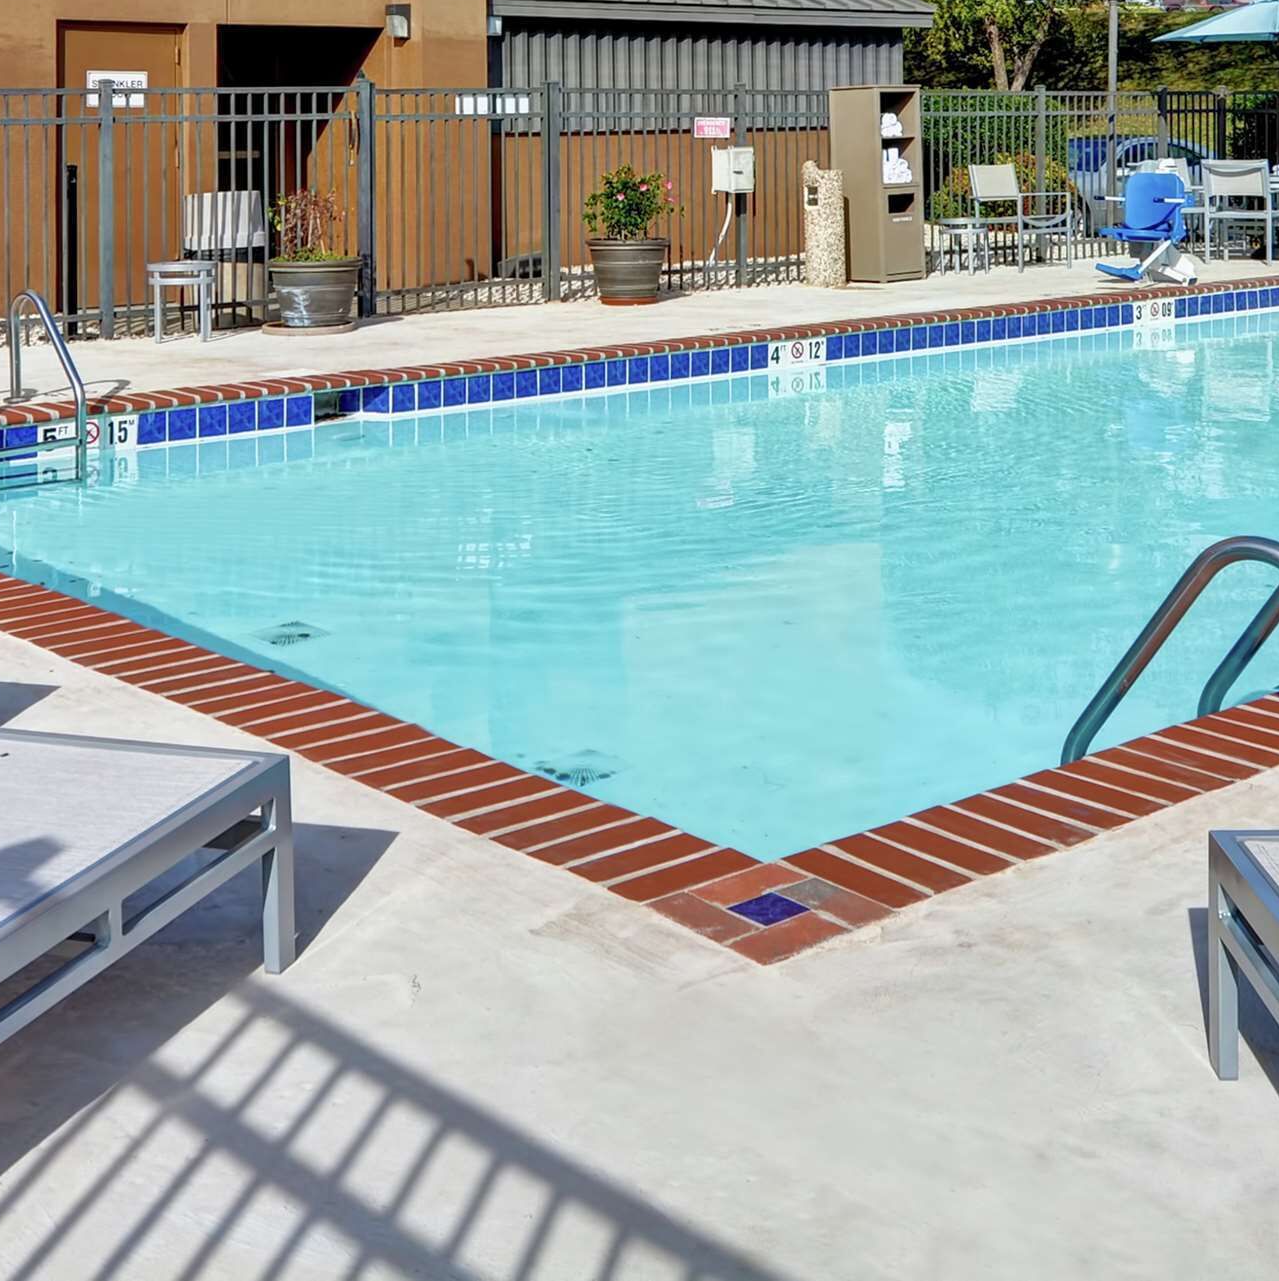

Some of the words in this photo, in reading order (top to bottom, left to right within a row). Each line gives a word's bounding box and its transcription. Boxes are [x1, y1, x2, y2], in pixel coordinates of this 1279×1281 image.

[91, 80, 143, 88] SNKLER
[1136, 305, 1142, 320] 3
[771, 346, 780, 364] 4
[58, 426, 68, 436] FT
